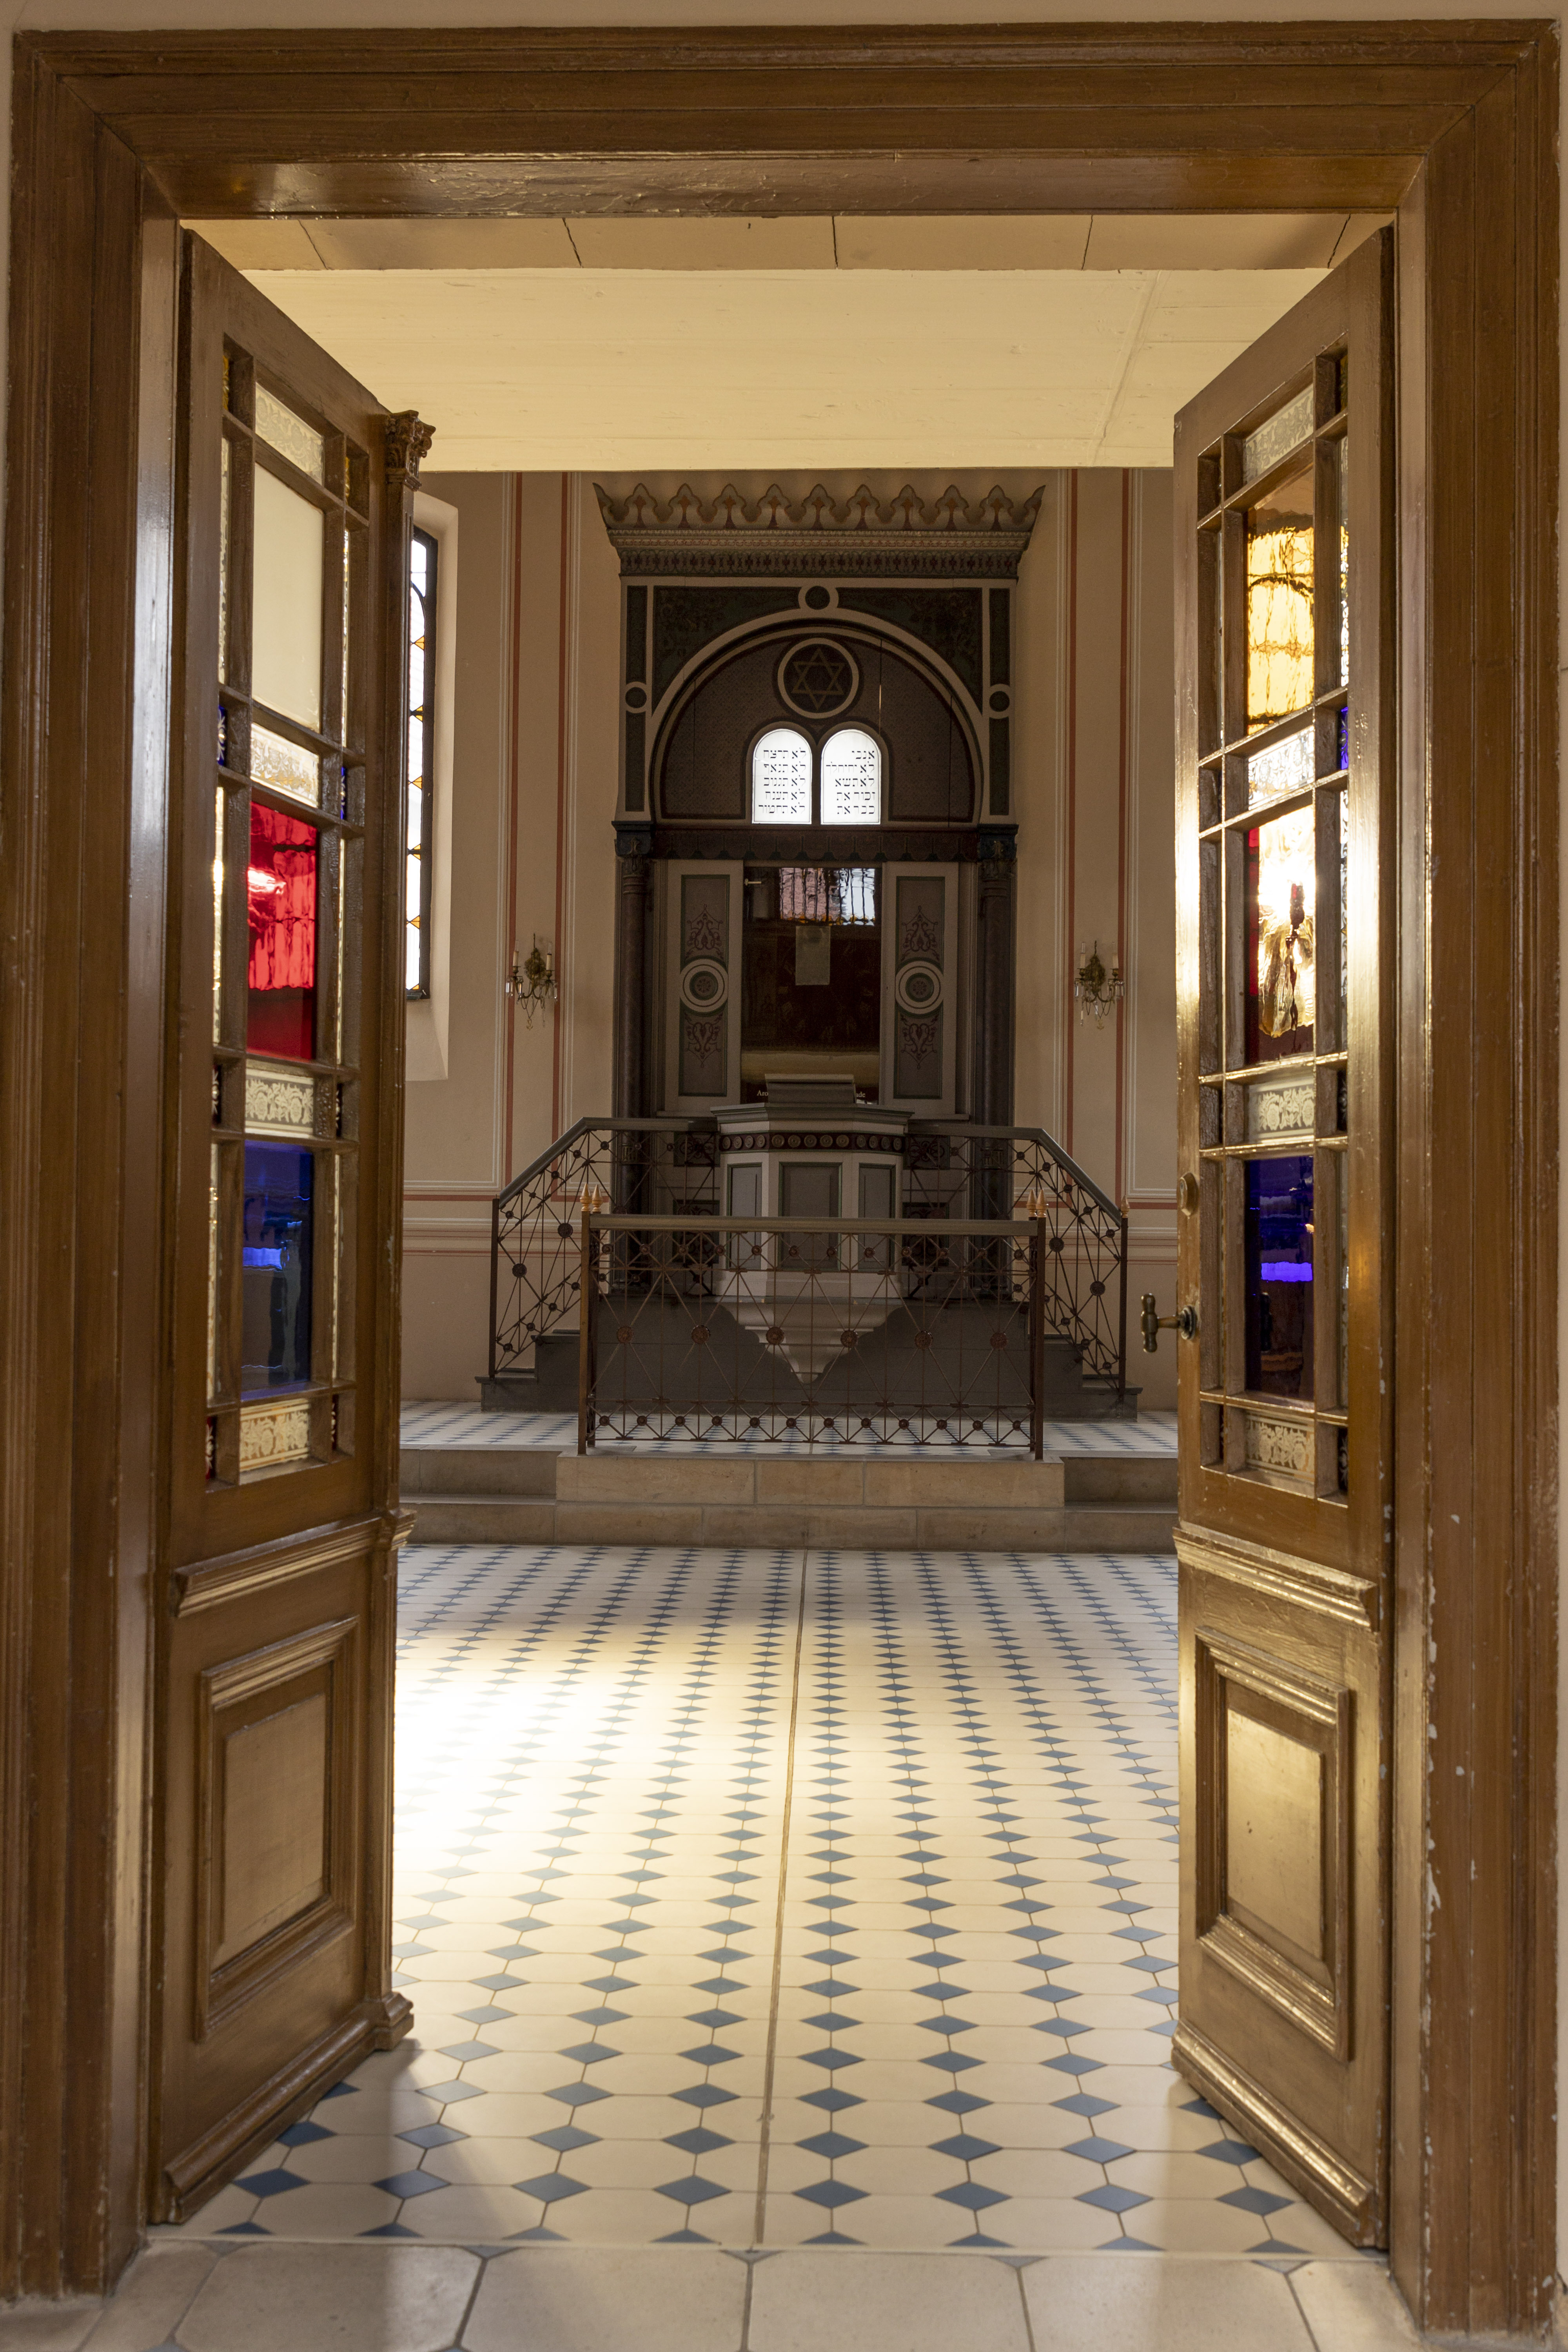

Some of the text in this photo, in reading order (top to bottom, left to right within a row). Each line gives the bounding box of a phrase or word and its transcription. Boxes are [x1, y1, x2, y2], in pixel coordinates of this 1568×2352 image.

[763, 747, 806, 759] לא תרצח
[852, 751, 875, 759] אנכי
[791, 761, 806, 773] לא
[860, 761, 875, 773] לא
[791, 775, 806, 786] לא
[765, 788, 805, 800] לא תענה
[837, 792, 875, 800] זכור את
[791, 802, 805, 814] לא
[837, 806, 850, 814] את
